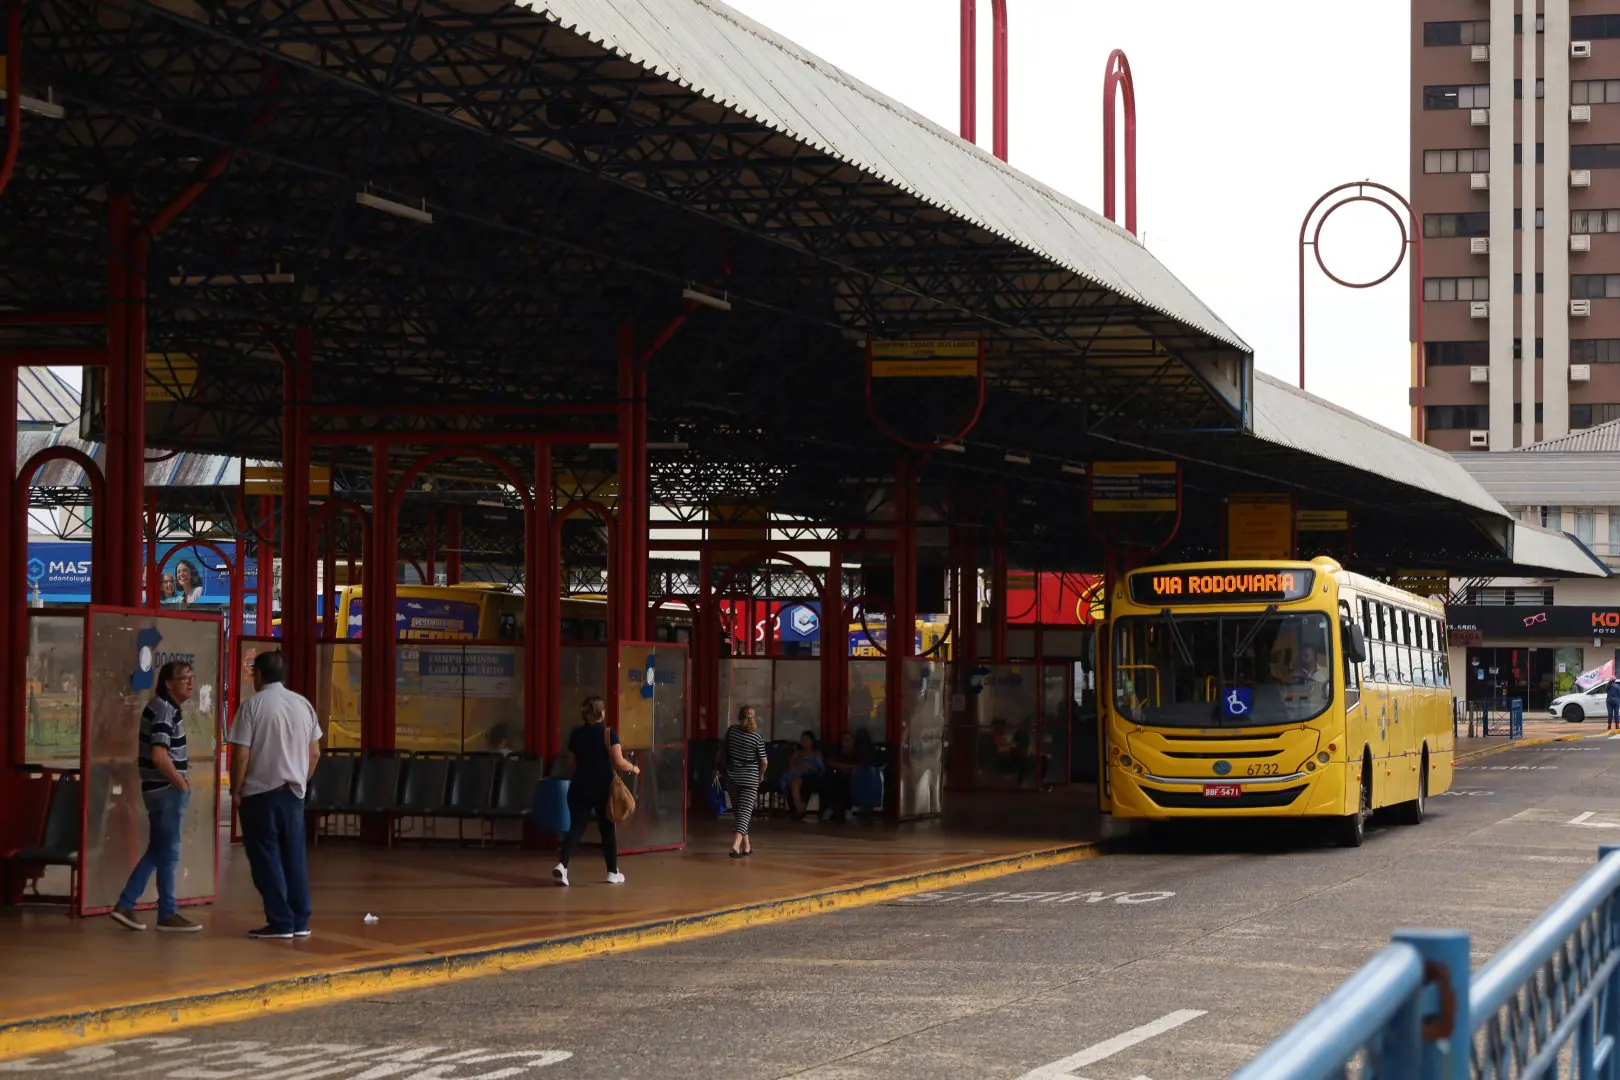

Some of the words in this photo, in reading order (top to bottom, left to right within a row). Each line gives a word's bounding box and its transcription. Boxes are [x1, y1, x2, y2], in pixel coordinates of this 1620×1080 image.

[48, 575, 91, 583] odontologia
[1153, 576, 1182, 594] VIA
[1188, 573, 1295, 593] RODOVIARIA
[1247, 763, 1279, 775] 6732
